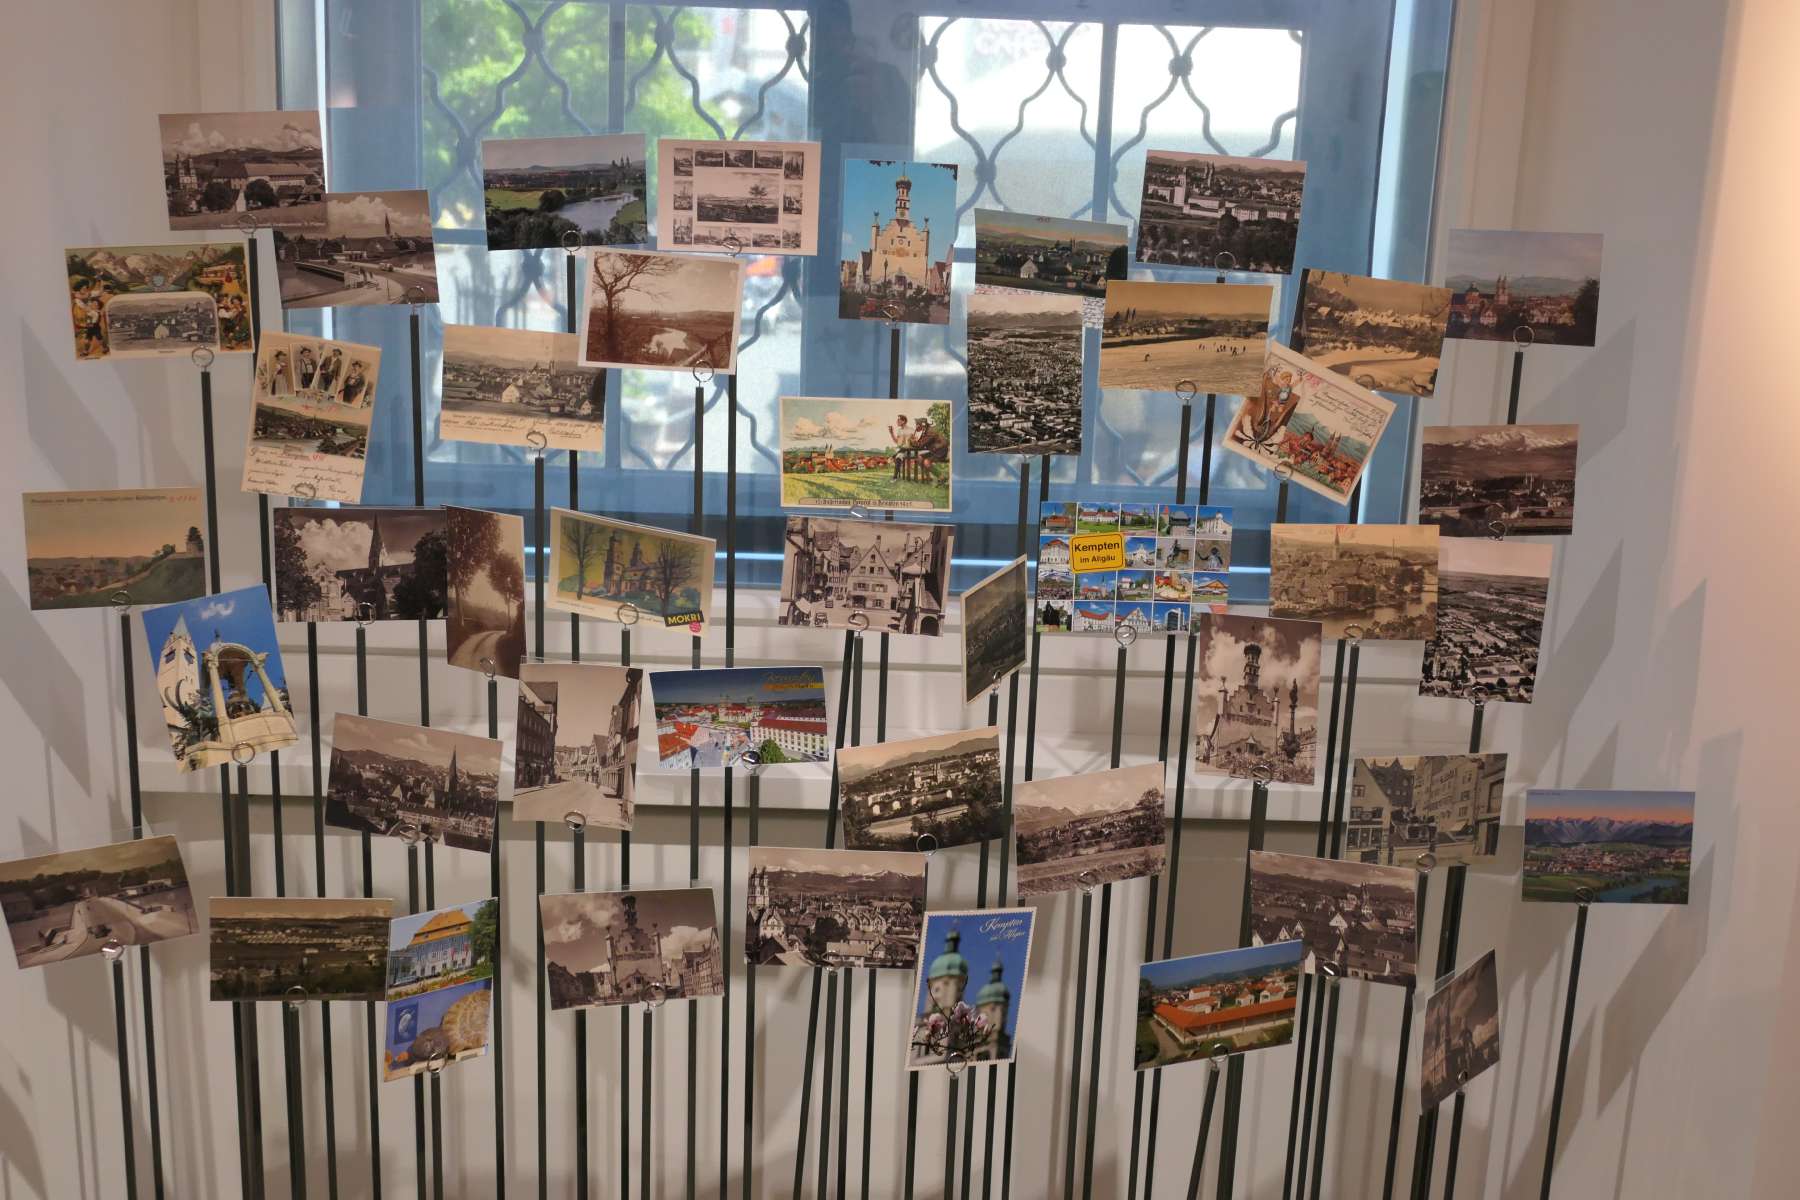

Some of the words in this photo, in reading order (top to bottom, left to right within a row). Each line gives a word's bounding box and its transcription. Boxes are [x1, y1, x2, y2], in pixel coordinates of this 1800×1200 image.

[1074, 542, 1120, 552] Kempten
[1080, 556, 1090, 564] im
[1091, 555, 1116, 564] Allgäu
[667, 613, 701, 625] MOKRI
